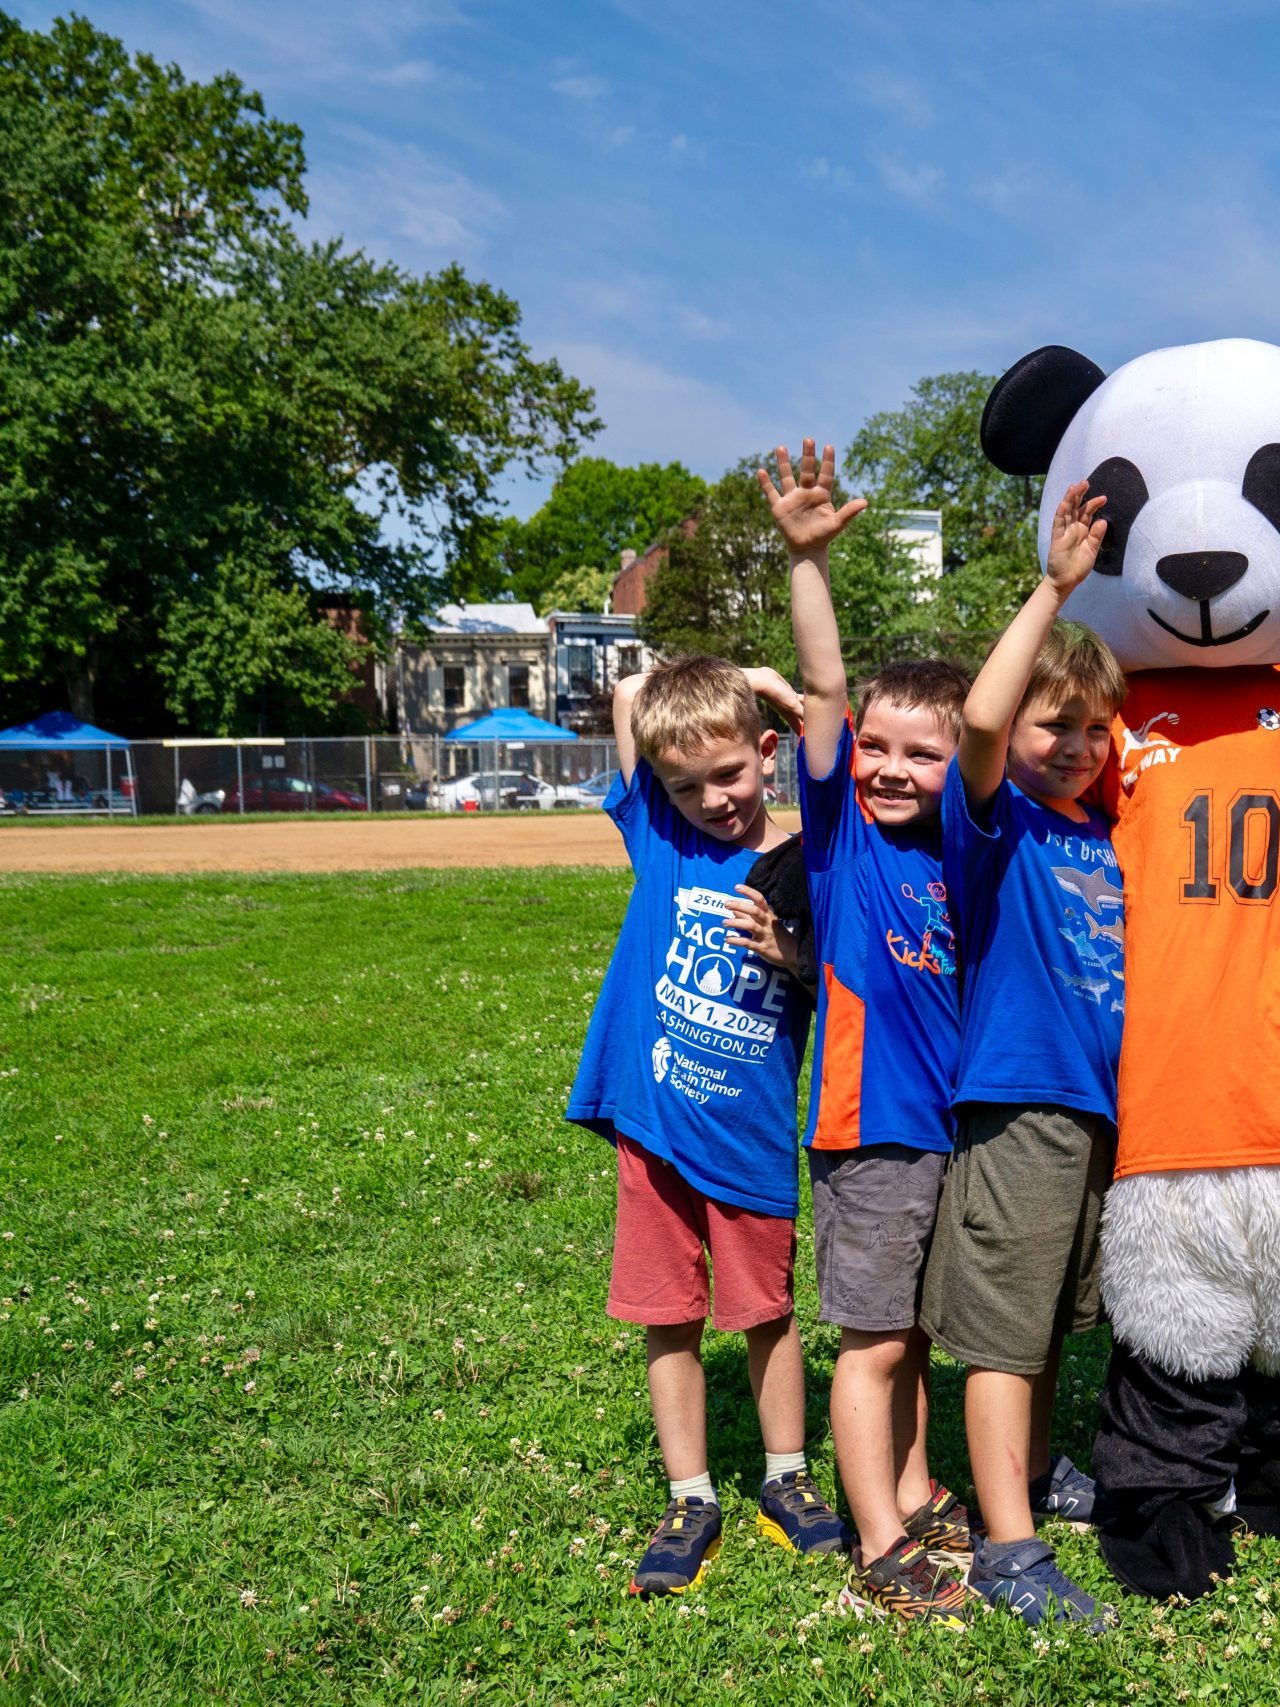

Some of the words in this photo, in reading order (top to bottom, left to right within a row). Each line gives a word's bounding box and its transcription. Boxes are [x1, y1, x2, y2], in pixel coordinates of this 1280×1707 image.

[1140, 747, 1182, 772] WAY
[693, 894, 725, 909] 25th
[676, 910, 741, 955] RACE
[886, 929, 941, 975] Kicks
[666, 937, 790, 1013] HOPE
[659, 983, 702, 1016] MAY
[706, 1007, 718, 1026] 1,
[724, 1012, 771, 1038] 2022
[656, 1008, 746, 1056] ASHINGTON,
[749, 1043, 770, 1058] DC
[672, 1062, 699, 1087] Bain
[700, 1076, 742, 1098] Tumor
[673, 1051, 728, 1081] National
[669, 1073, 710, 1105] Society
